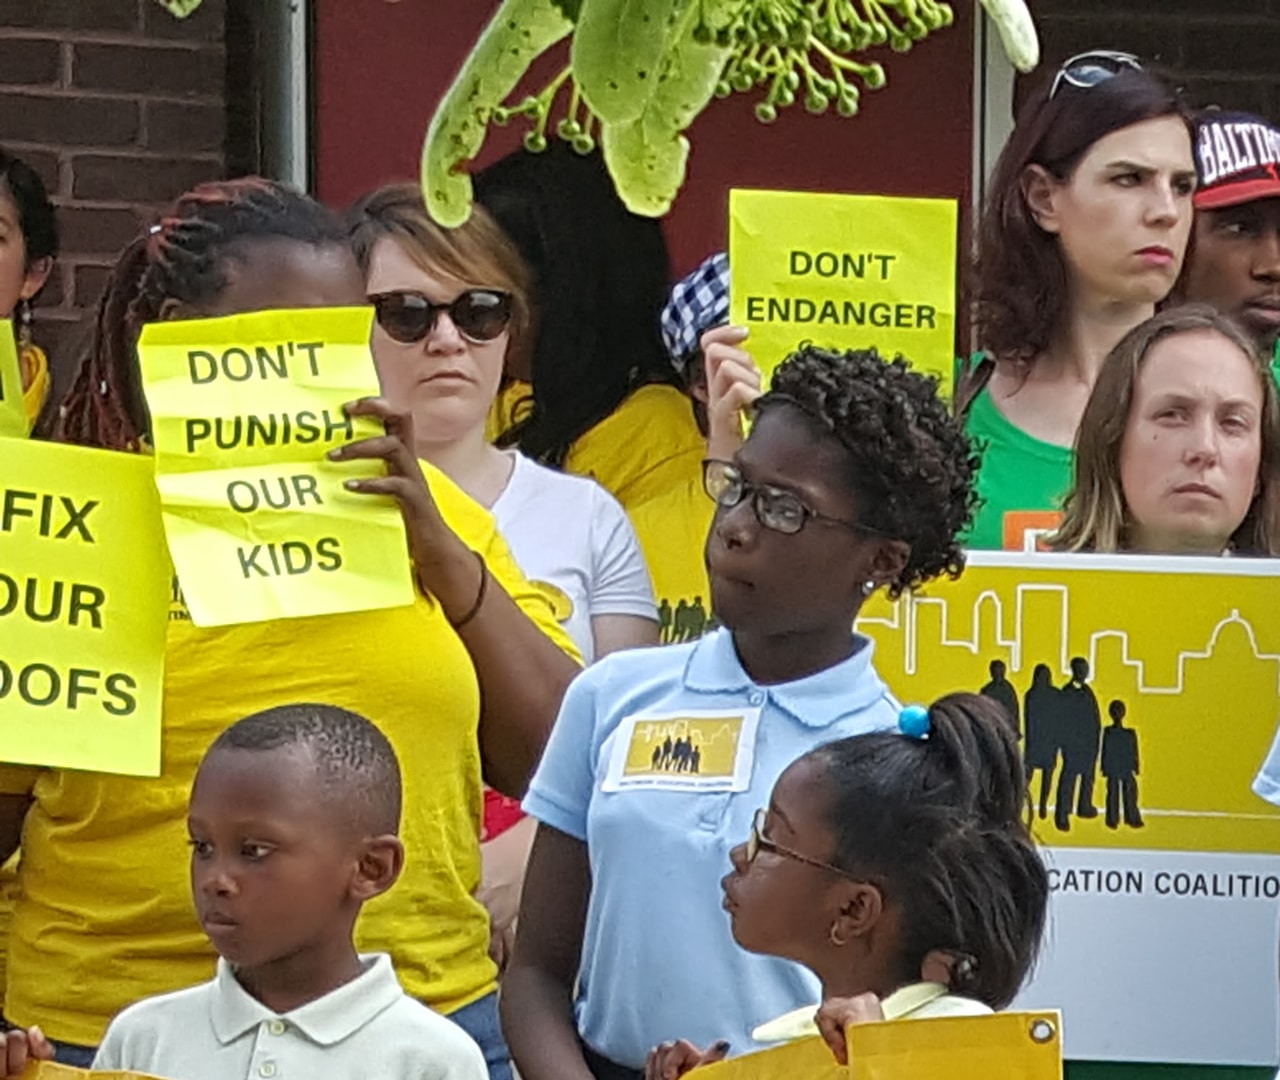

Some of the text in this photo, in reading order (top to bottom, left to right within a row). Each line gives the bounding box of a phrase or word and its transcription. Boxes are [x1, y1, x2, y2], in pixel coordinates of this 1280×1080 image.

[789, 250, 897, 281] DON'T
[745, 296, 936, 329] ENDANGER
[187, 341, 325, 385] DON'T
[185, 409, 354, 453] PUNISH
[226, 473, 324, 514] OUR
[1, 488, 100, 544] FIX
[236, 536, 343, 579] KIDS
[0, 658, 138, 717] OFS
